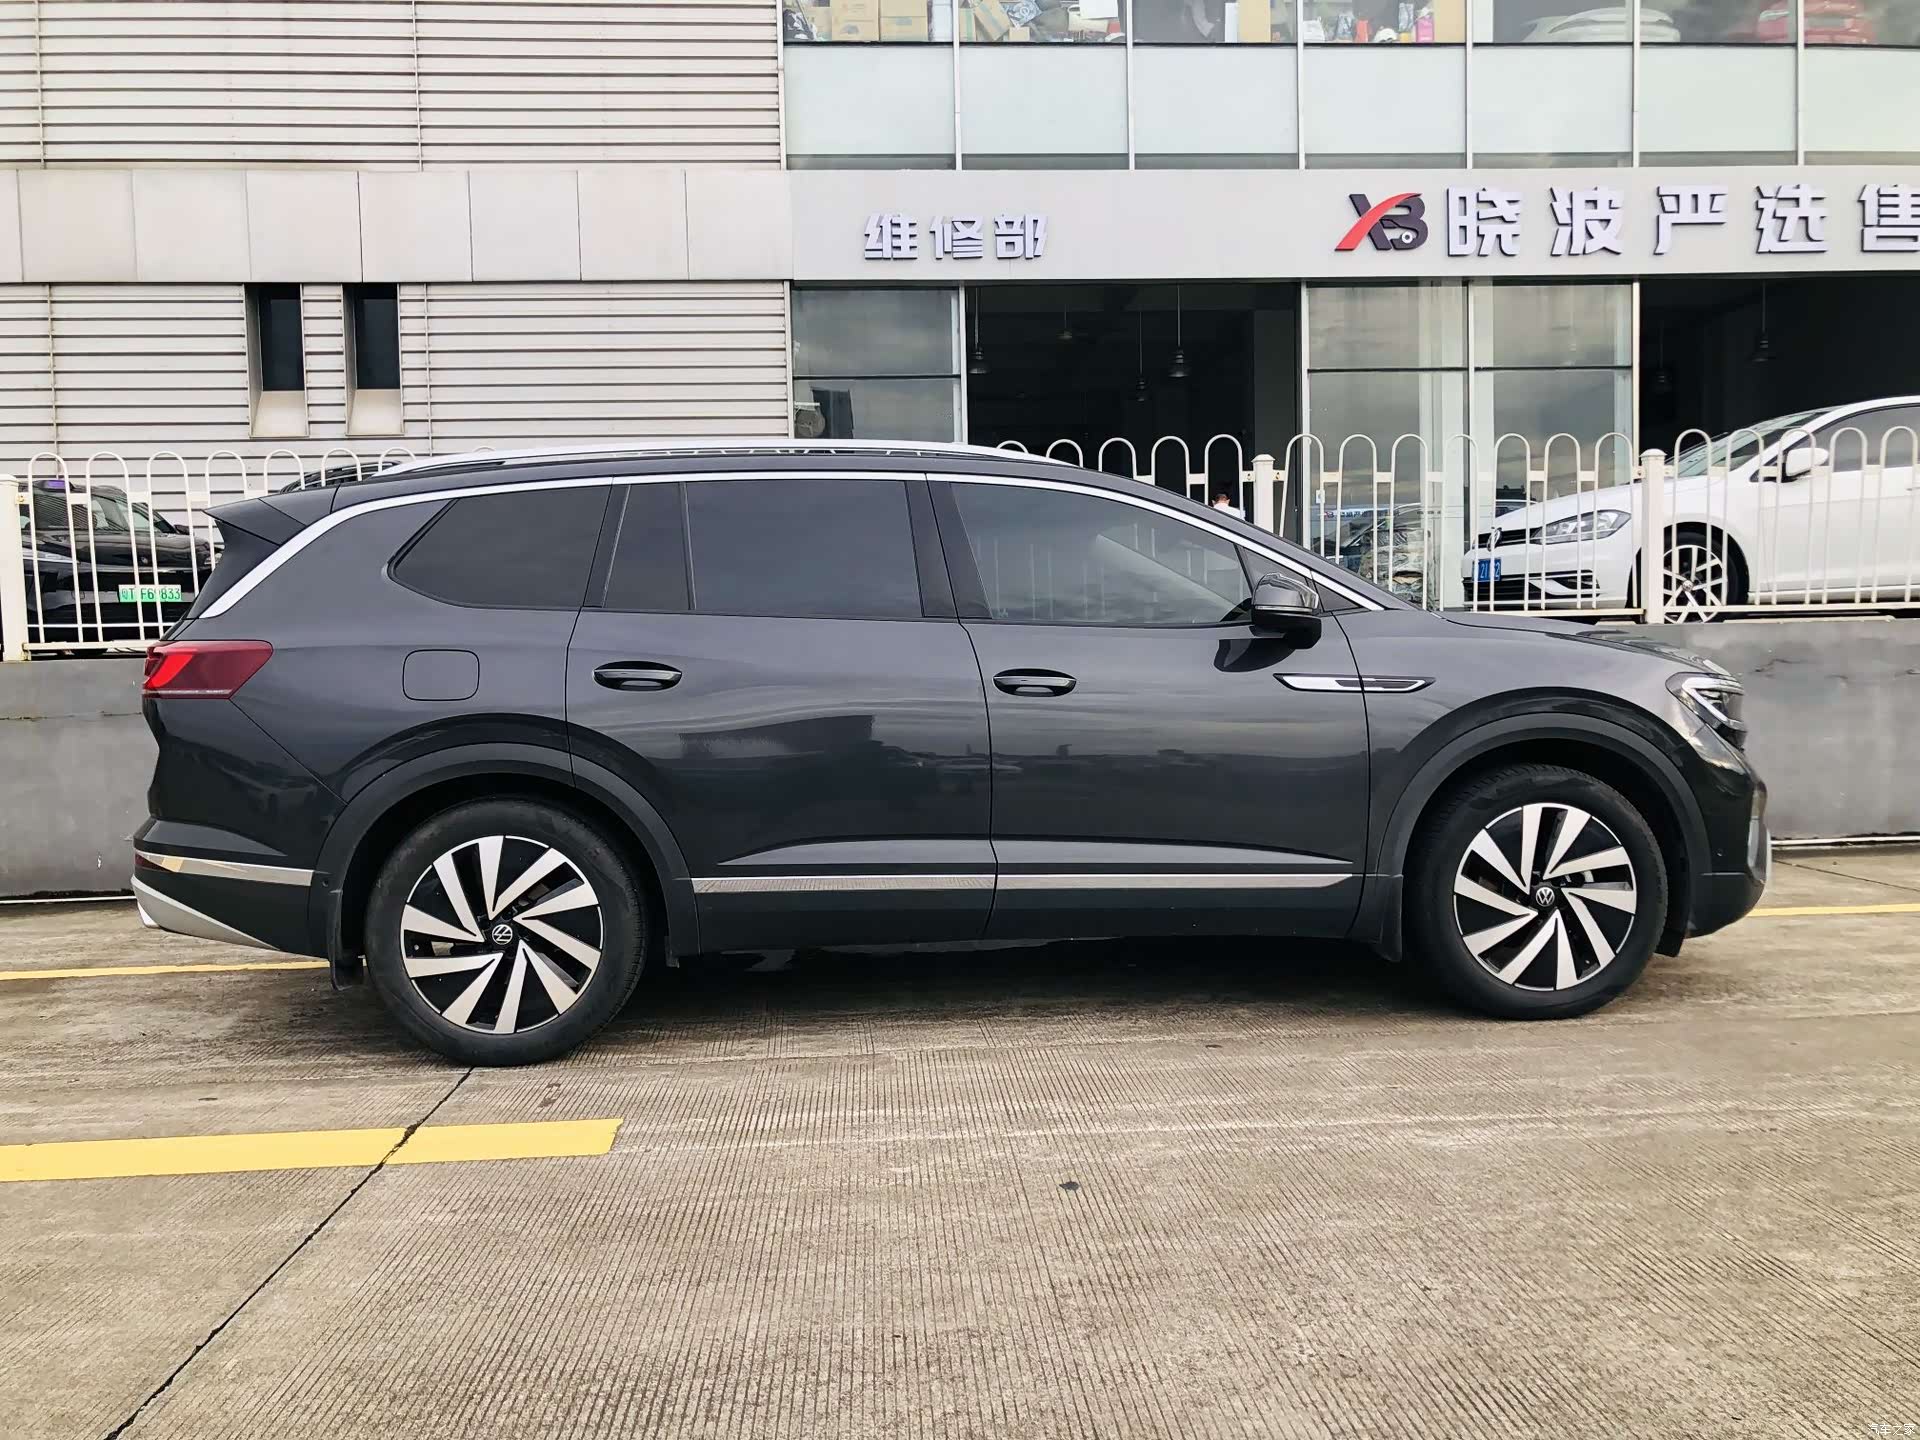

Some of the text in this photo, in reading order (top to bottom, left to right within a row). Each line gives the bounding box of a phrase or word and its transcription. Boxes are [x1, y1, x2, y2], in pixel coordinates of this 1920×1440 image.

[864, 213, 1048, 260] 维修部
[1446, 183, 1920, 257] 晓波严选售
